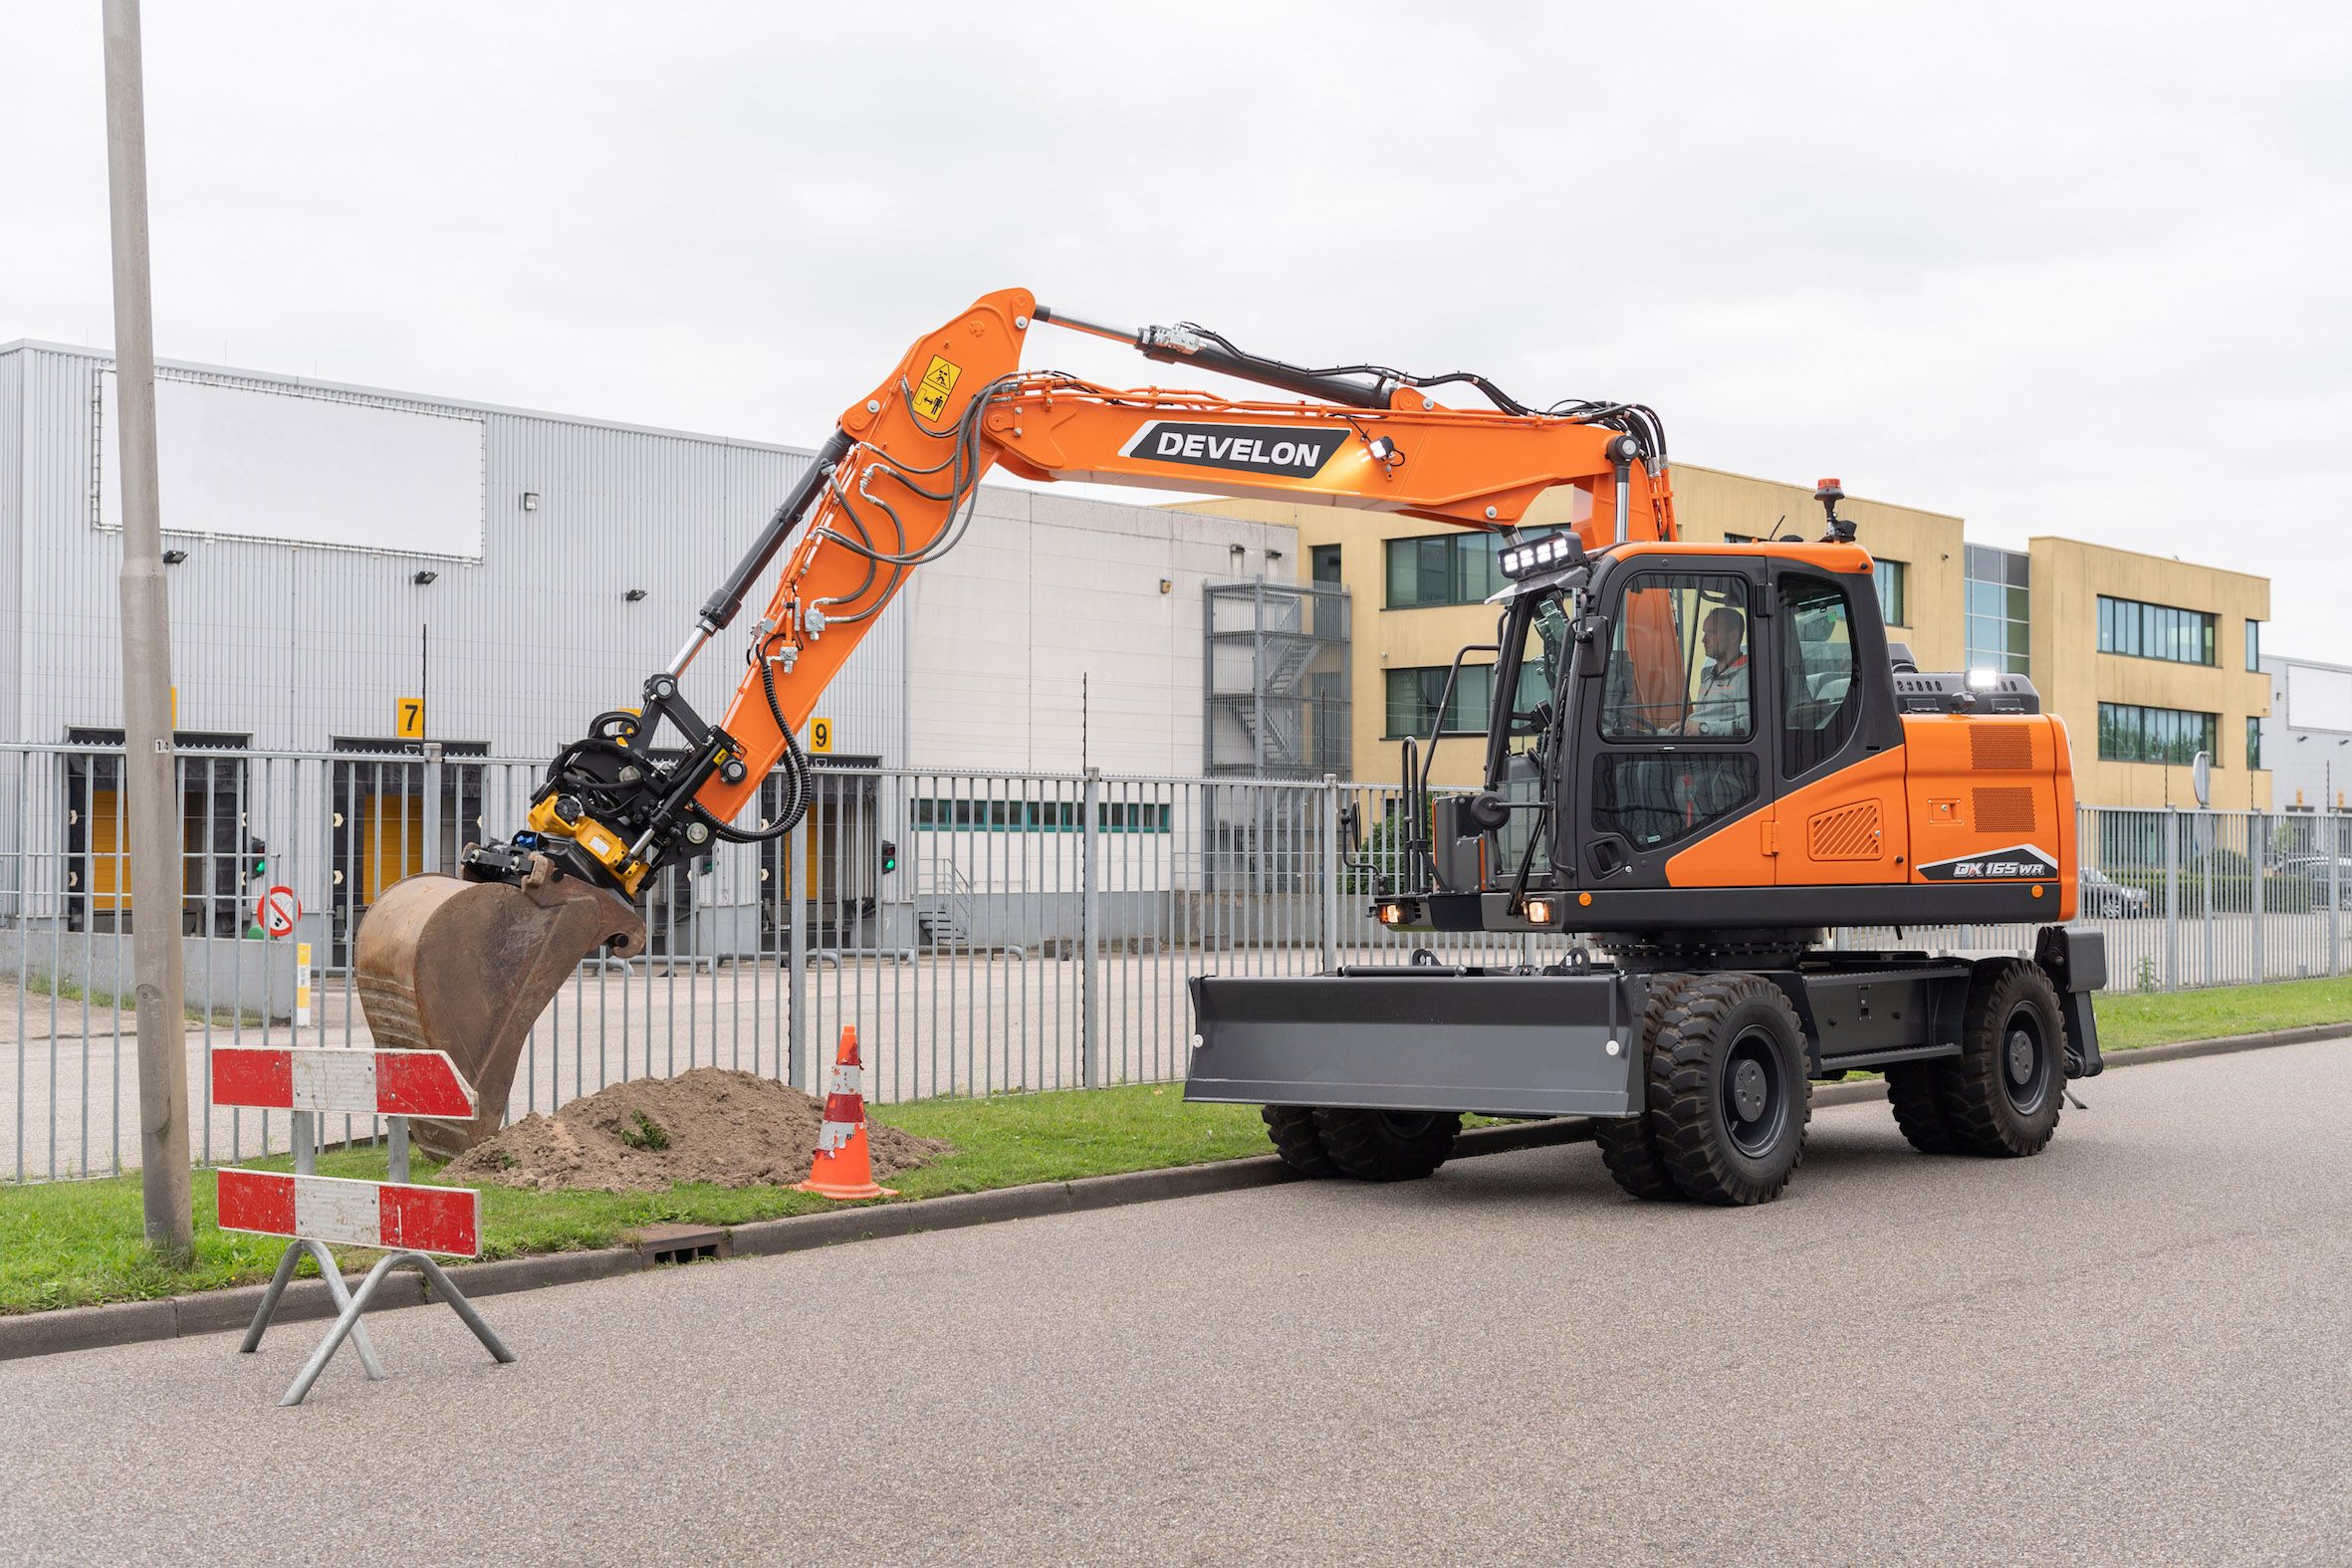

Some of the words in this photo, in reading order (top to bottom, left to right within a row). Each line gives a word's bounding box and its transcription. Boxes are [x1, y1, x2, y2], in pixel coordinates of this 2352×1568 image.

[1156, 431, 1321, 468] DEVELON
[405, 705, 418, 731] 7
[816, 723, 826, 747] 9
